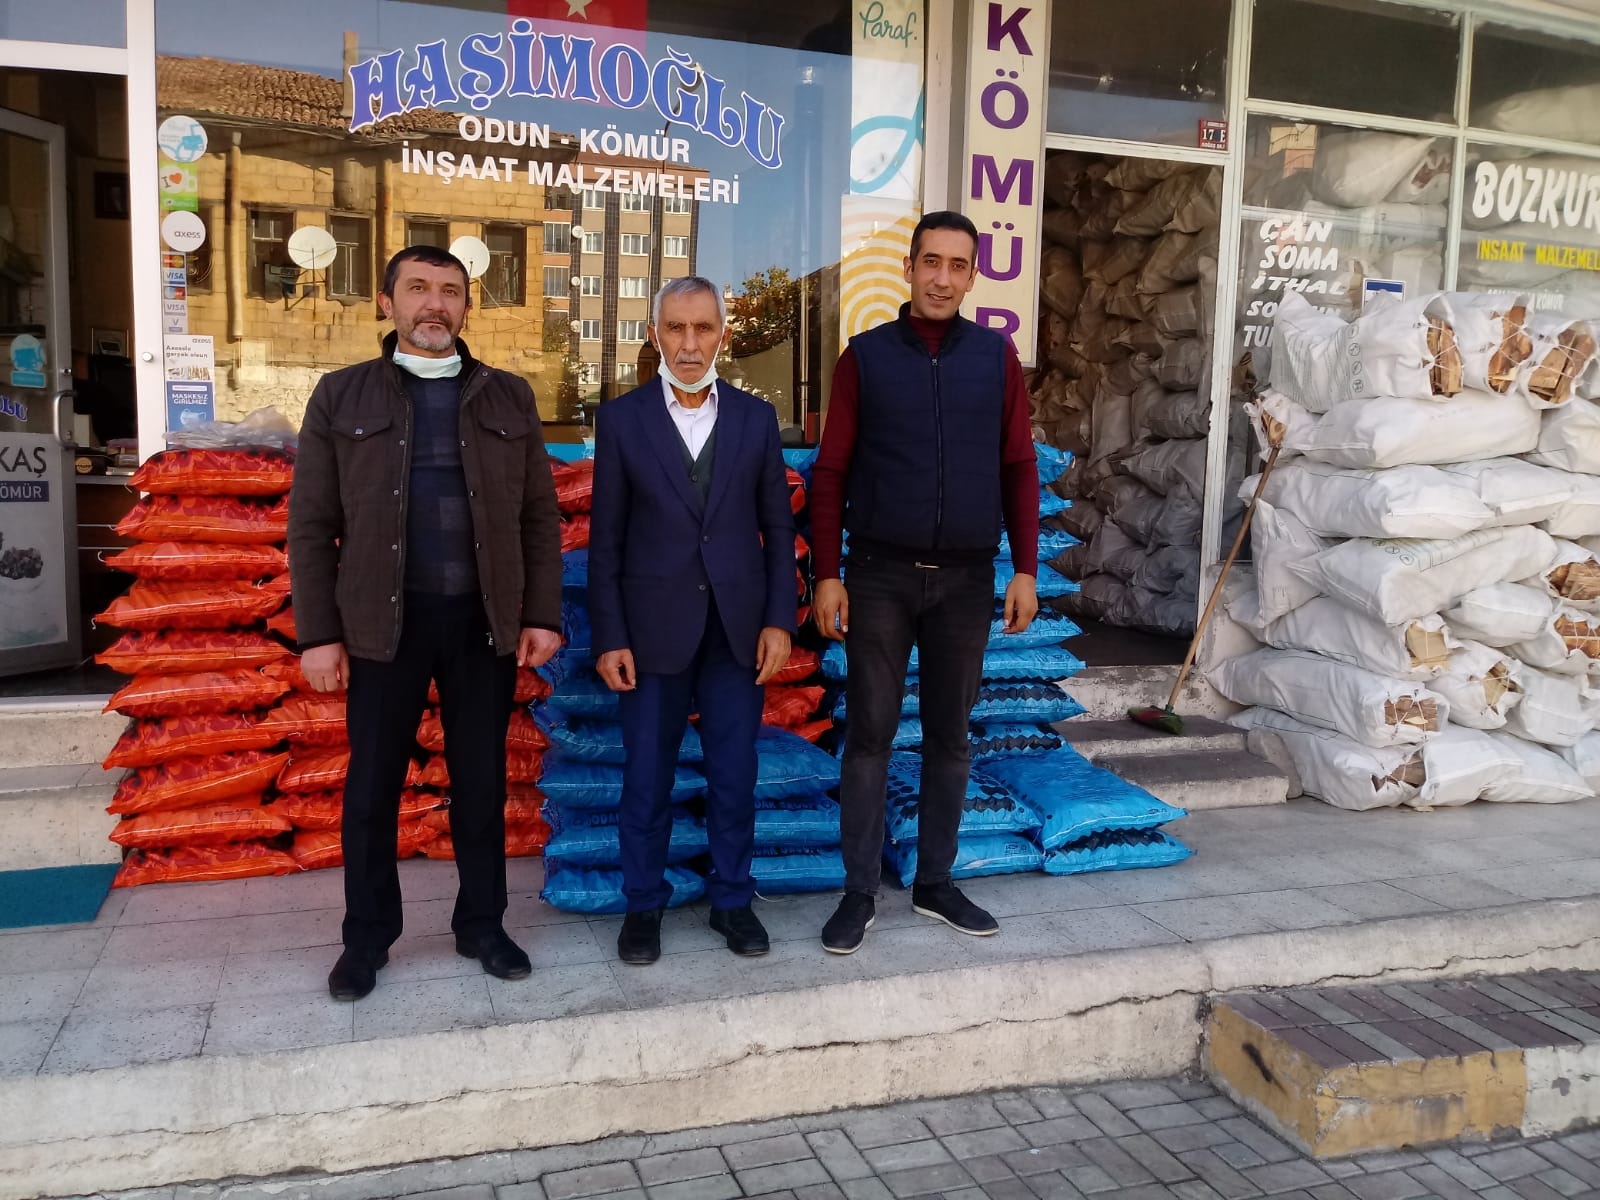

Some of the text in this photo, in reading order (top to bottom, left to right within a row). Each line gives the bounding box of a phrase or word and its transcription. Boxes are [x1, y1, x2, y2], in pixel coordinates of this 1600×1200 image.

[348, 18, 785, 169] HAŞİMOĞLU
[458, 115, 550, 149] ODUN
[580, 124, 690, 163] KÖMÜR
[401, 141, 740, 204] İNŞAAT MALZEMELERİ
[971, 2, 1035, 355] KÖMÜR
[174, 230, 201, 239] axess
[1259, 245, 1339, 271] SOMA
[167, 271, 185, 280] VISA
[1250, 271, 1347, 296] İTHAL
[167, 303, 185, 311] VISA
